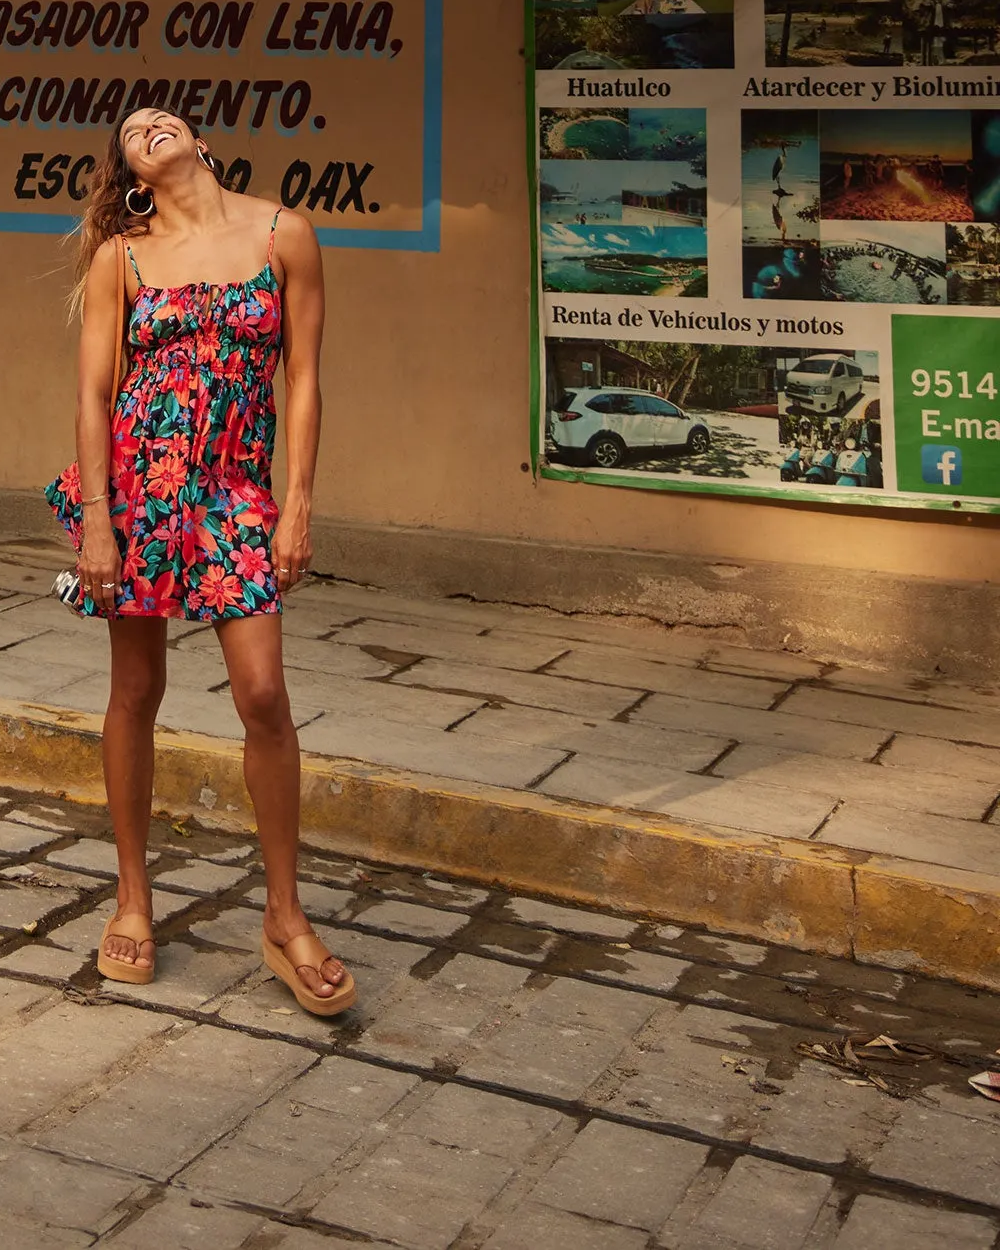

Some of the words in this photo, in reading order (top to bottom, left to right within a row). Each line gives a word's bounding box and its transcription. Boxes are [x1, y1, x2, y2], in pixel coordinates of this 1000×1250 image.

[164, 1, 255, 49] CON
[567, 78, 671, 97] Huatulco
[743, 77, 865, 97] Atardecer
[871, 81, 886, 101] y
[279, 161, 381, 214] OAX.
[552, 306, 612, 326] Renta
[618, 308, 643, 327] de
[648, 310, 751, 332] Vehículos
[757, 318, 770, 336] y
[776, 317, 844, 336] motos
[911, 369, 998, 400] 9514
